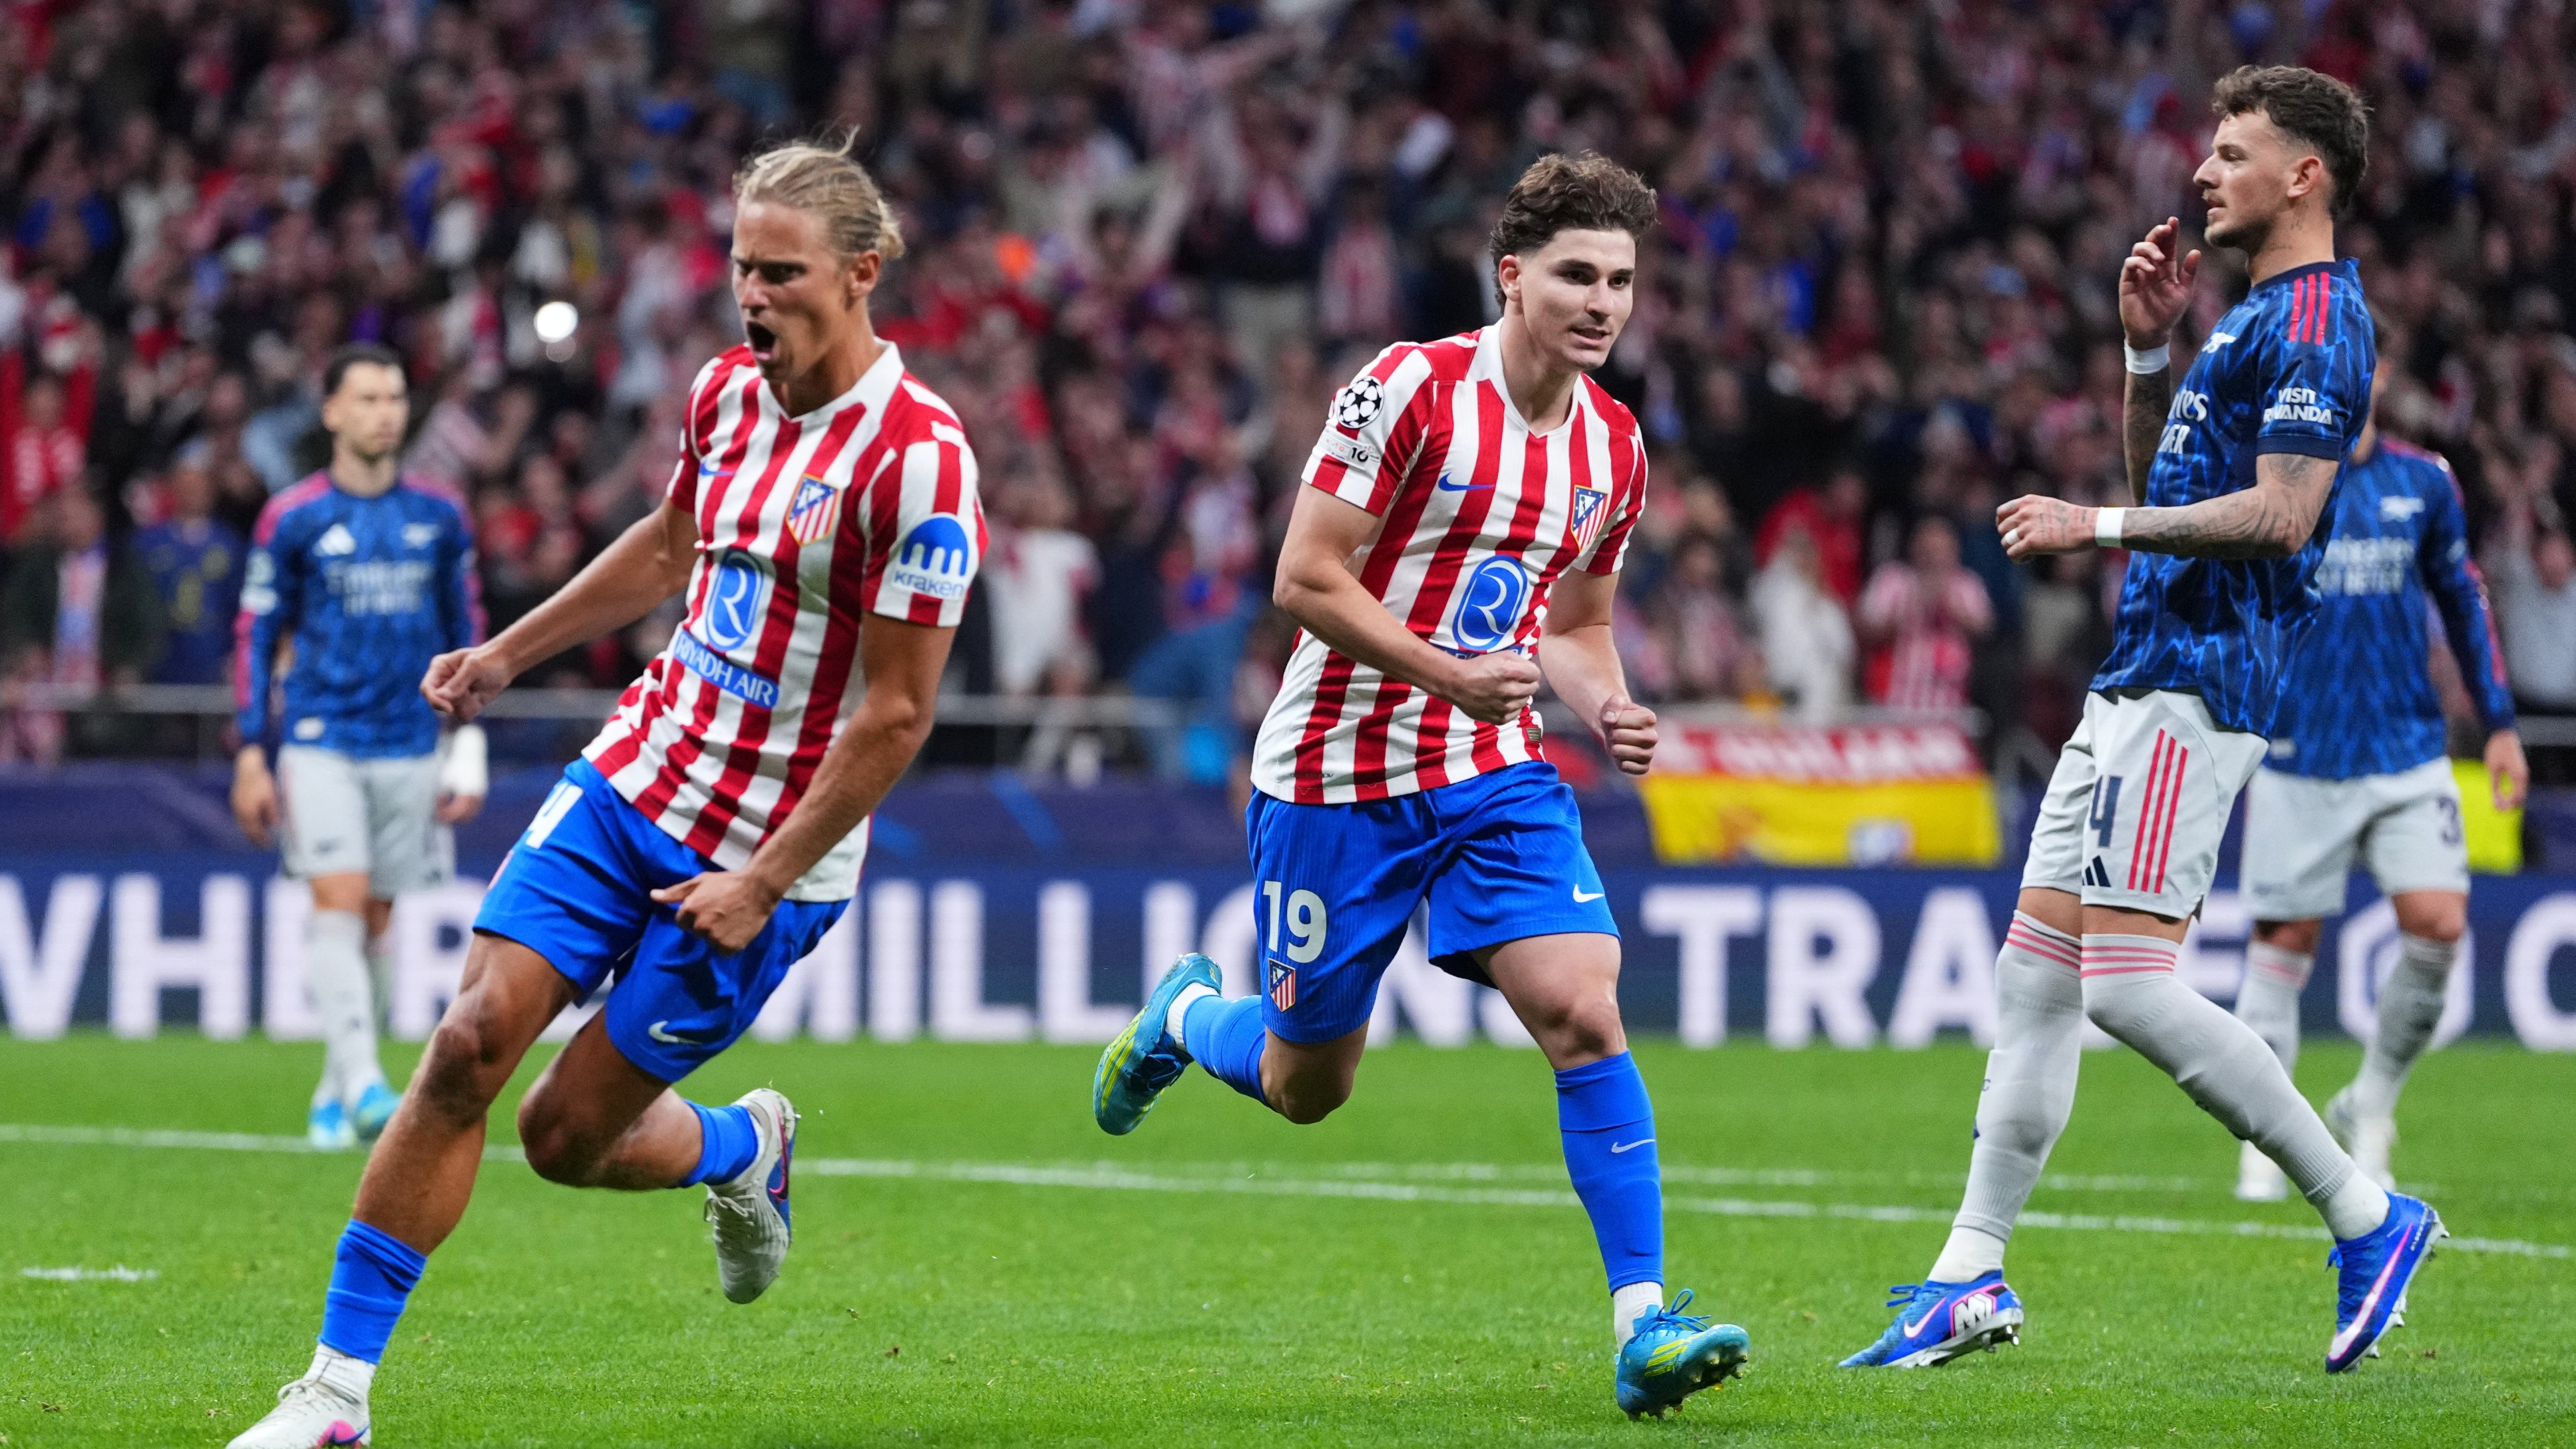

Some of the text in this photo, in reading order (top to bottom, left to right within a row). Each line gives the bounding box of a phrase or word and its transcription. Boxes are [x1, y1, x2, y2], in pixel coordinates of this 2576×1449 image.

[2279, 387, 2316, 404] VISIT
[894, 570, 964, 596] kraken
[675, 633, 774, 706] RIYADH AIR
[1262, 881, 1327, 964] 19
